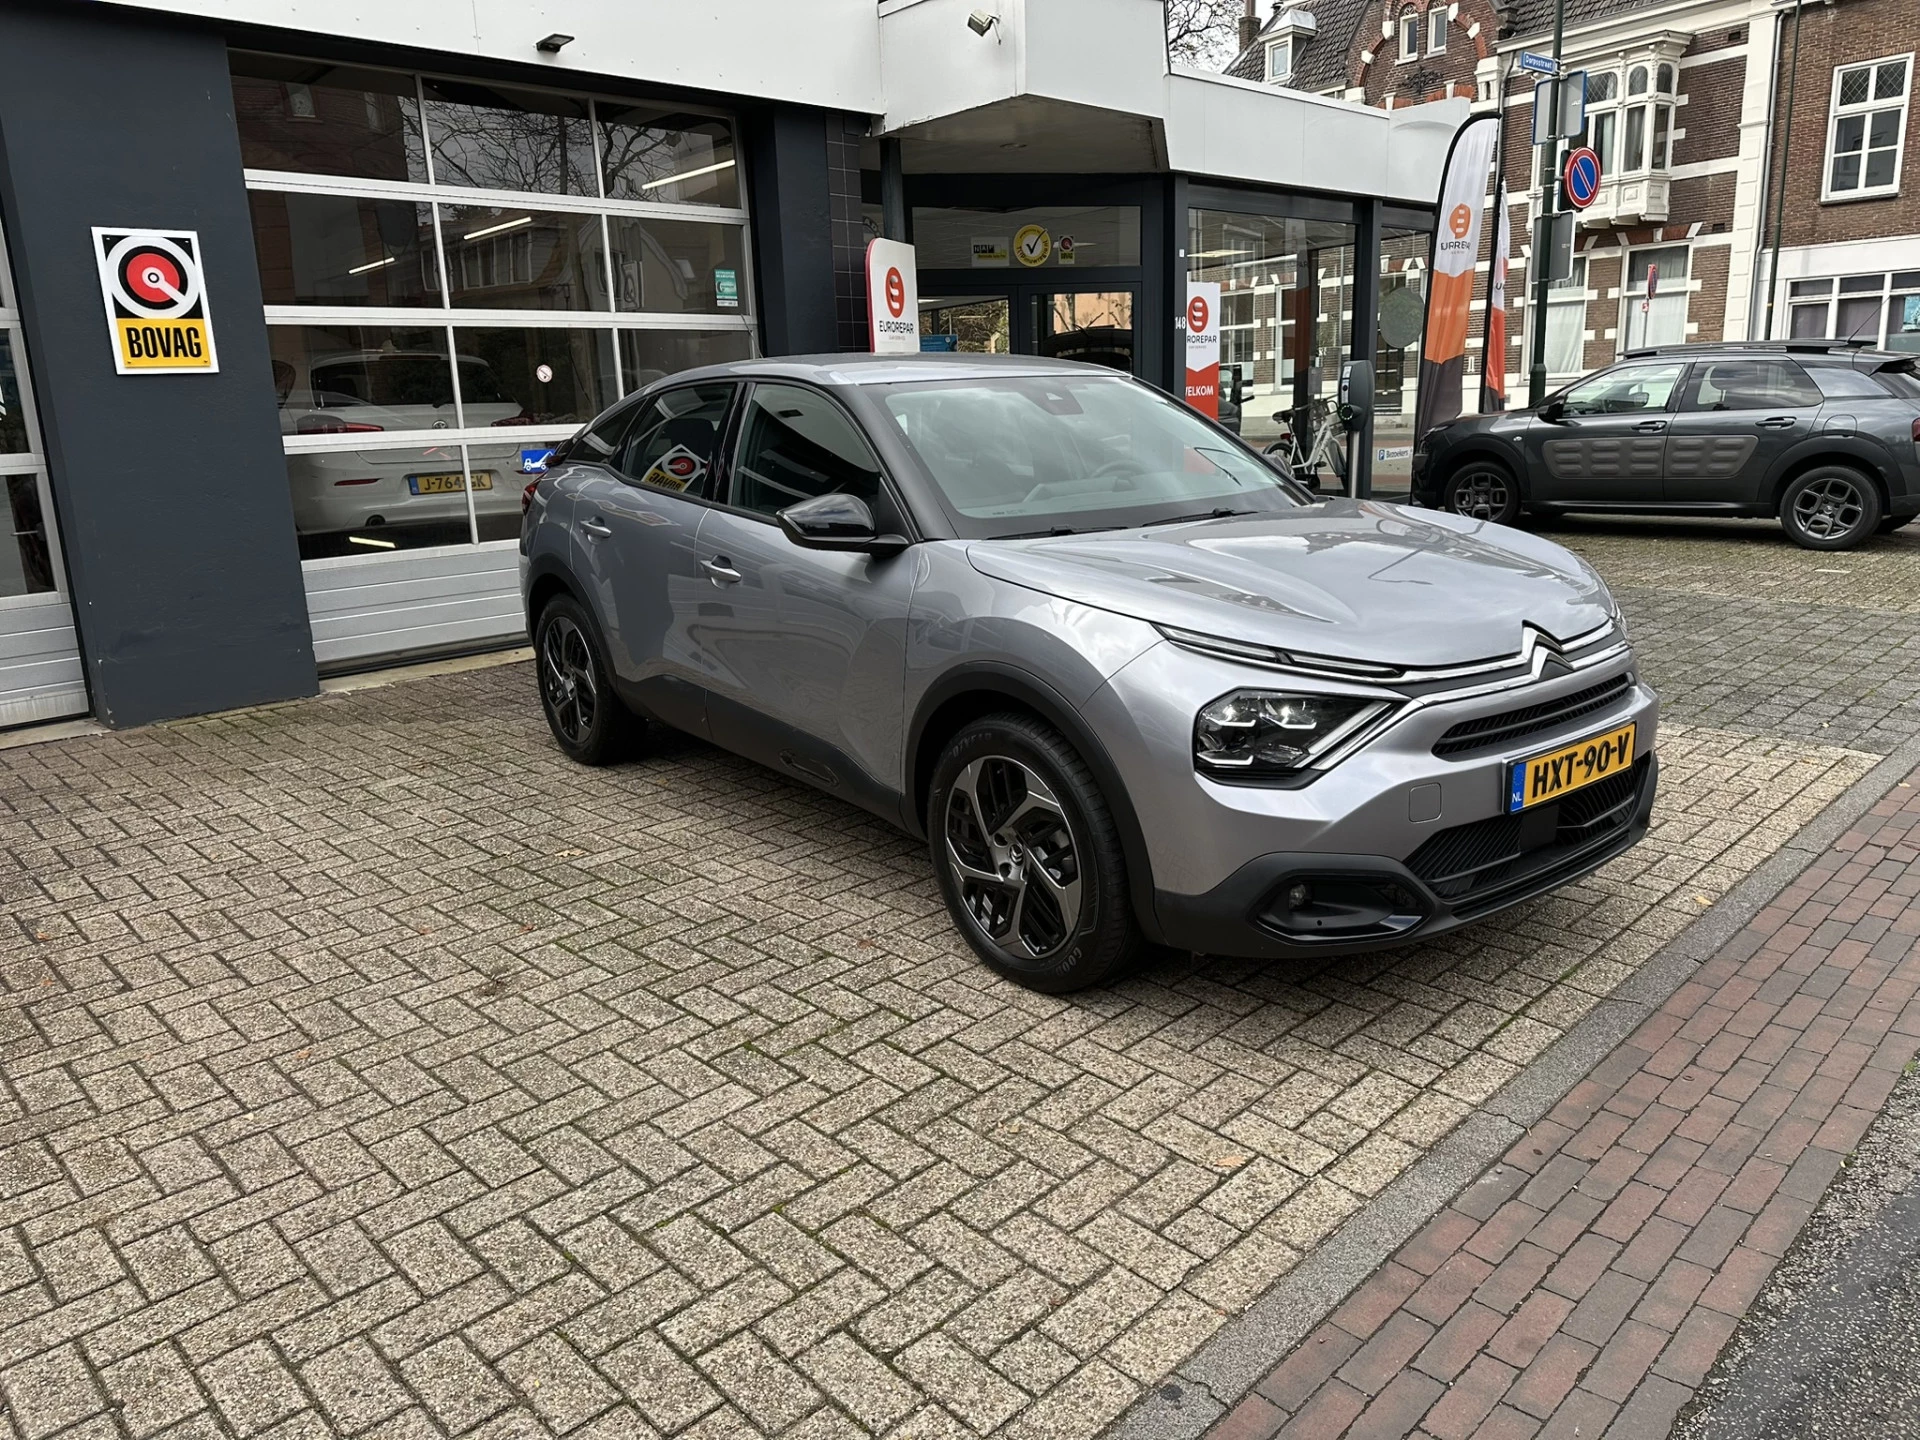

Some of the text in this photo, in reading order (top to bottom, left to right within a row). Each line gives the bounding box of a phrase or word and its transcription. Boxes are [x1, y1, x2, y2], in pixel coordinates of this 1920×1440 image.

[879, 320, 914, 334] EUROREPAR
[1175, 316, 1186, 330] 148
[126, 327, 202, 358] BOVAG
[1187, 335, 1217, 344] ROREPAR
[1532, 732, 1630, 798] HXT-90-V
[1512, 792, 1522, 803] NL
